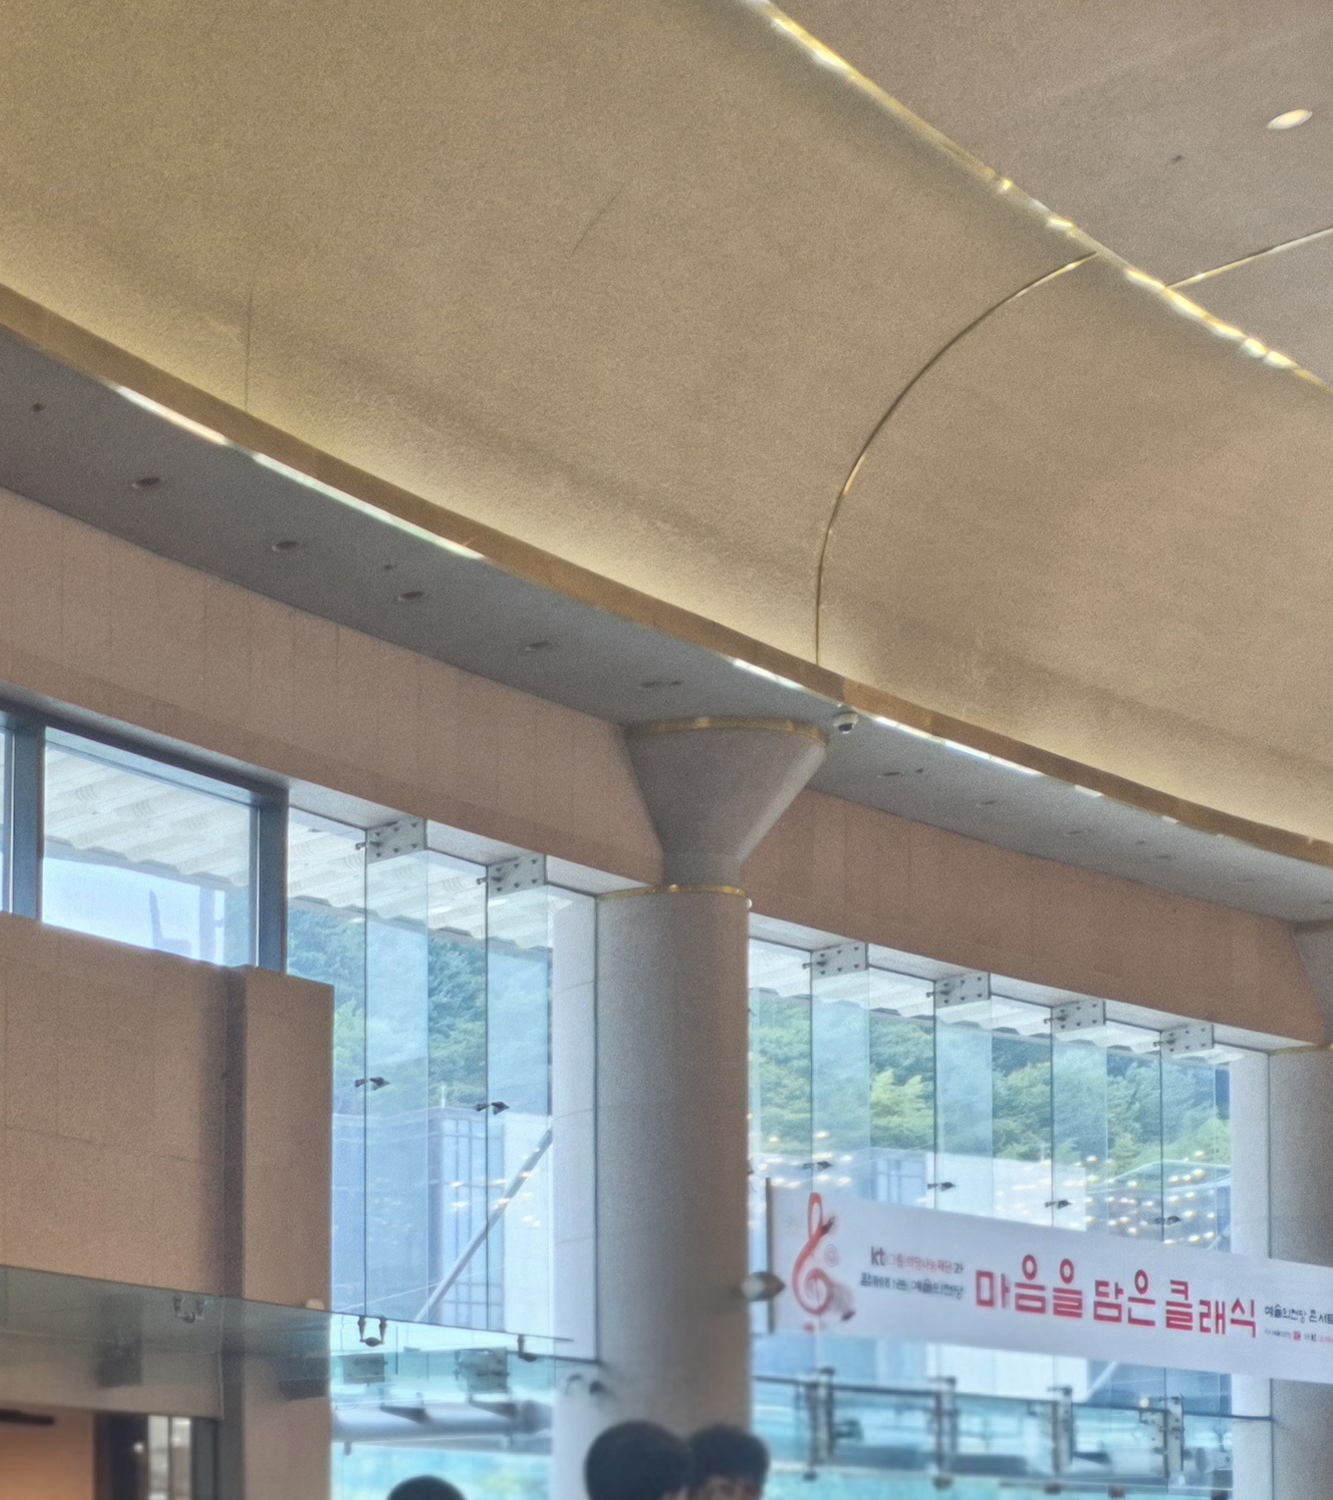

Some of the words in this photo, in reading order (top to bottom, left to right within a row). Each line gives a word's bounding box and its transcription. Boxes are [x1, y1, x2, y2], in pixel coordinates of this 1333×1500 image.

[975, 1254, 1083, 1318] 마음을
[1093, 1269, 1156, 1327] 담은
[1165, 1279, 1256, 1338] 클래식
